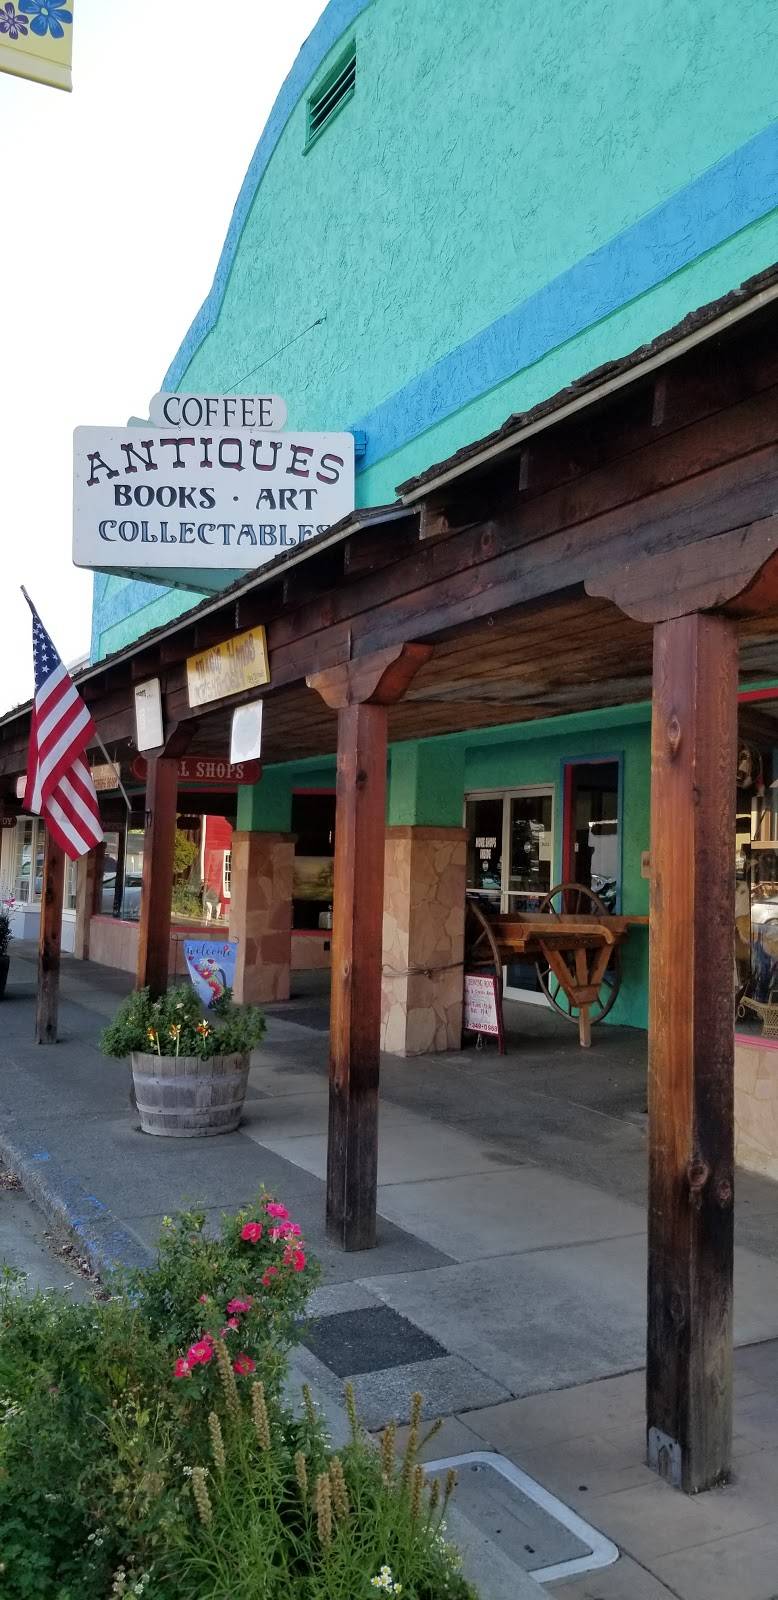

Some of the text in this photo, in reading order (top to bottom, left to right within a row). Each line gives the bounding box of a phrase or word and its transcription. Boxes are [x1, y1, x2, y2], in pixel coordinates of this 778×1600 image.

[163, 397, 274, 427] COFFEE
[86, 437, 344, 487] ANTIQUES
[113, 484, 318, 511] BOOKS ART
[196, 762, 244, 779] SHOPS
[187, 943, 232, 957] welcome
